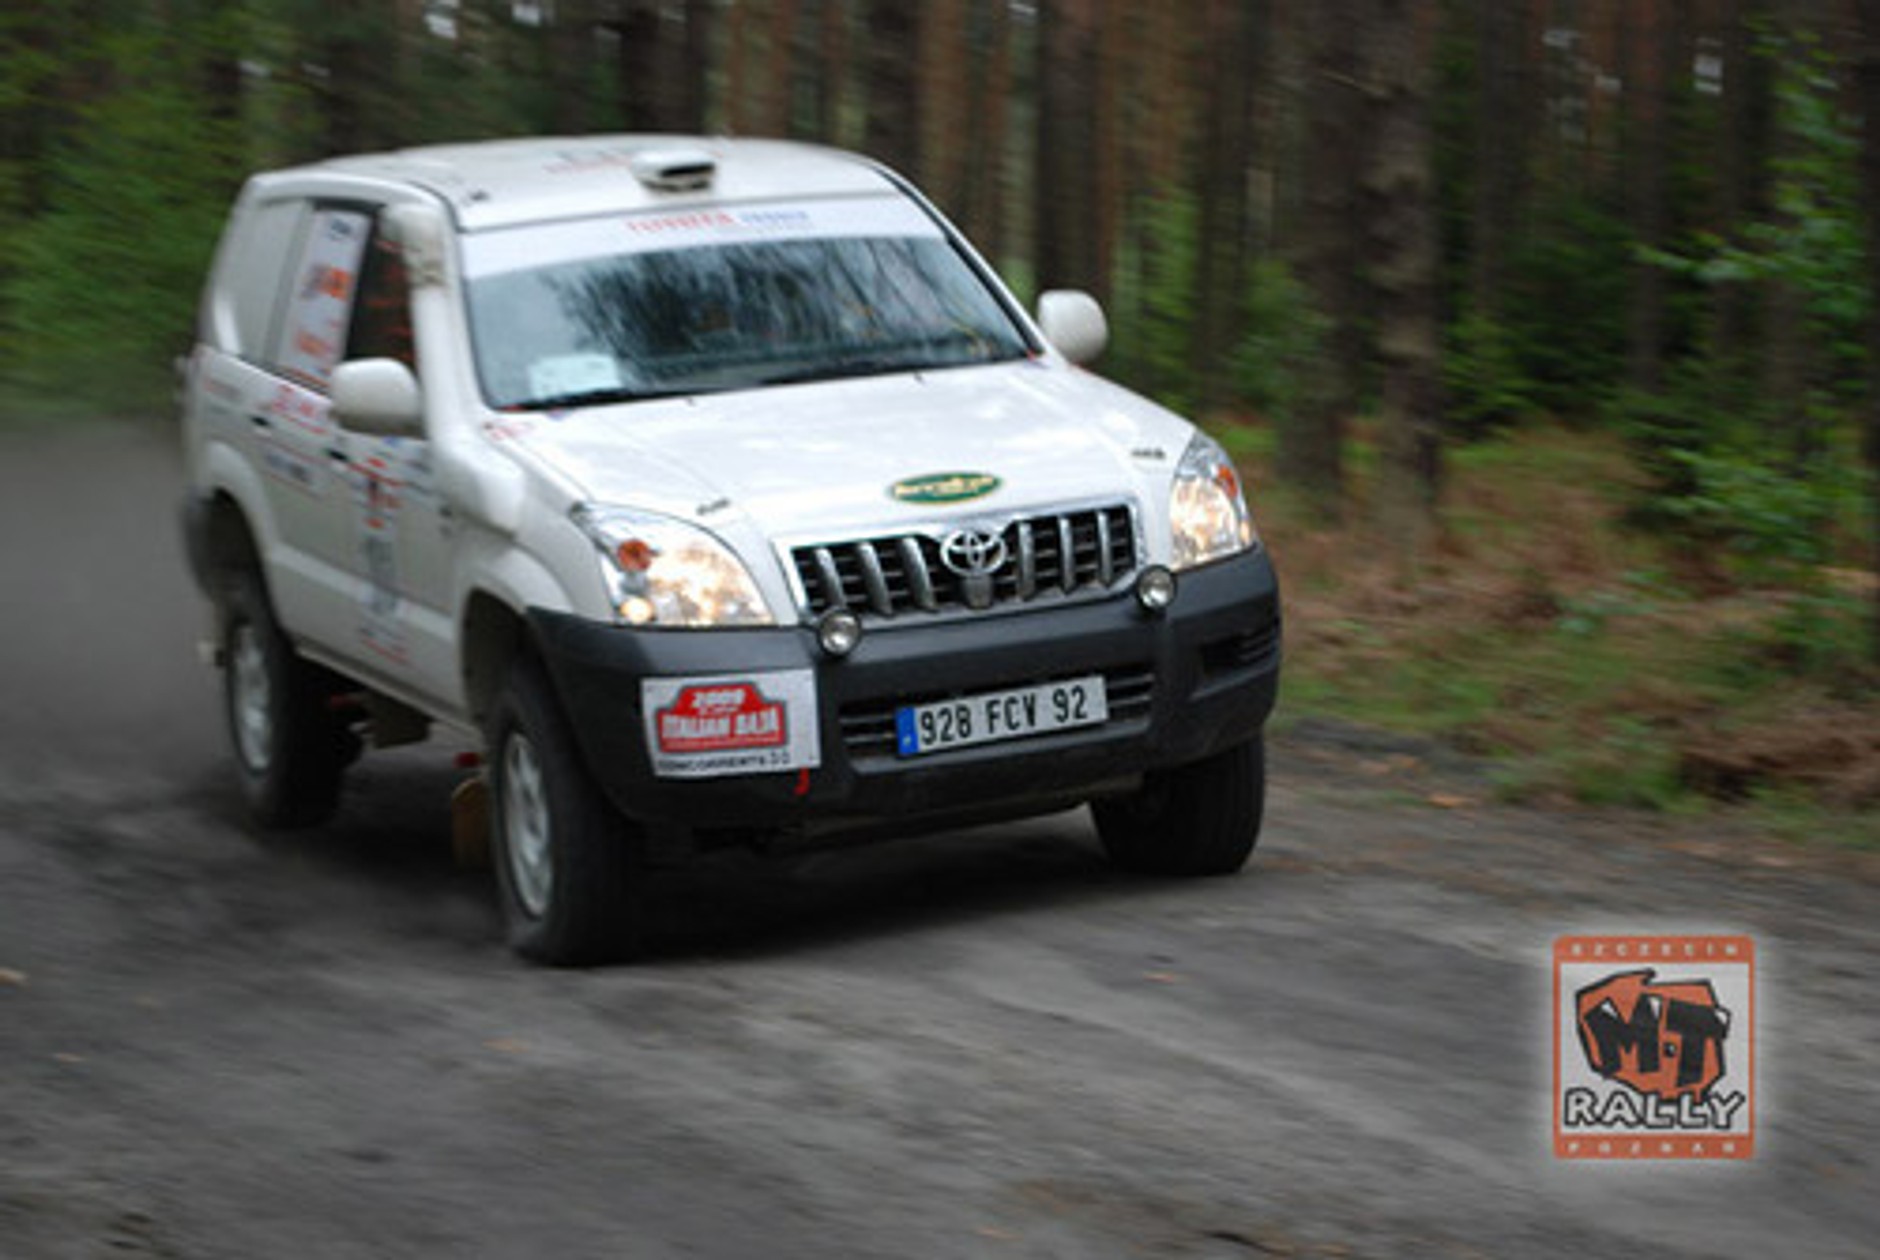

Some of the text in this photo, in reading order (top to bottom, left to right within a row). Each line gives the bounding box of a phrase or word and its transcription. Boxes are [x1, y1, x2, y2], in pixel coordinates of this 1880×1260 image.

[920, 684, 1087, 746] 928 FCV 92
